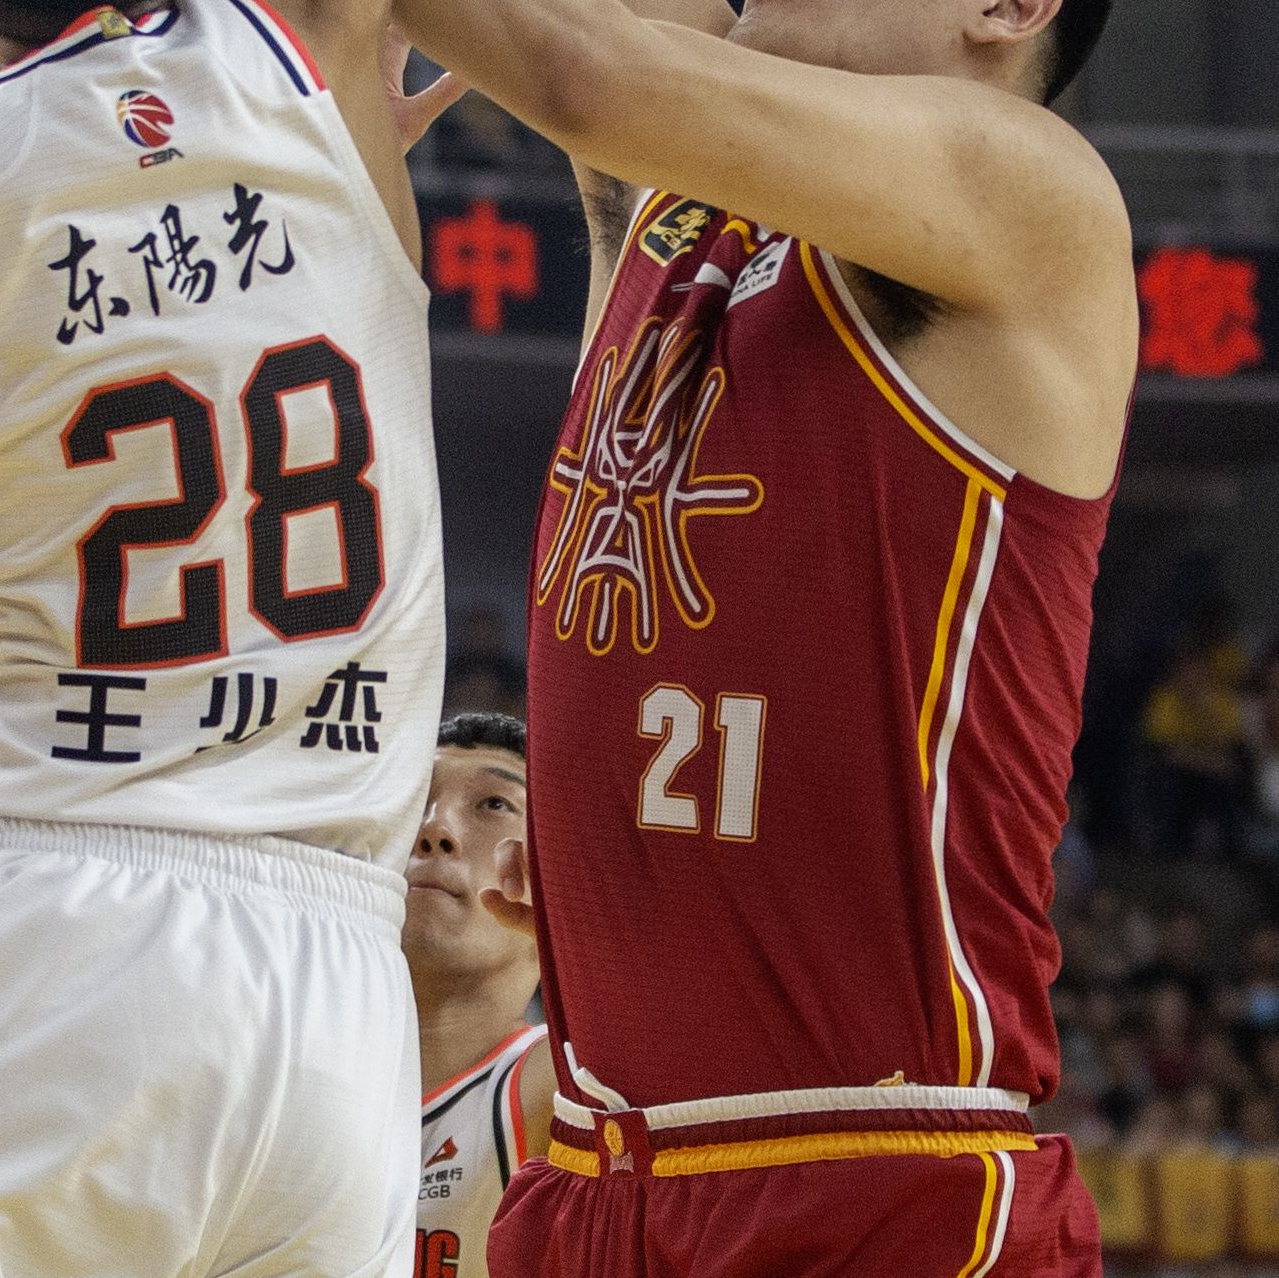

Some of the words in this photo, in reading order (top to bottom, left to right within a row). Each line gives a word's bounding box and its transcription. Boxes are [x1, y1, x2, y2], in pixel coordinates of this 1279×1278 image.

[433, 194, 540, 335] 中
[59, 333, 386, 670] 28
[637, 681, 769, 843] 21
